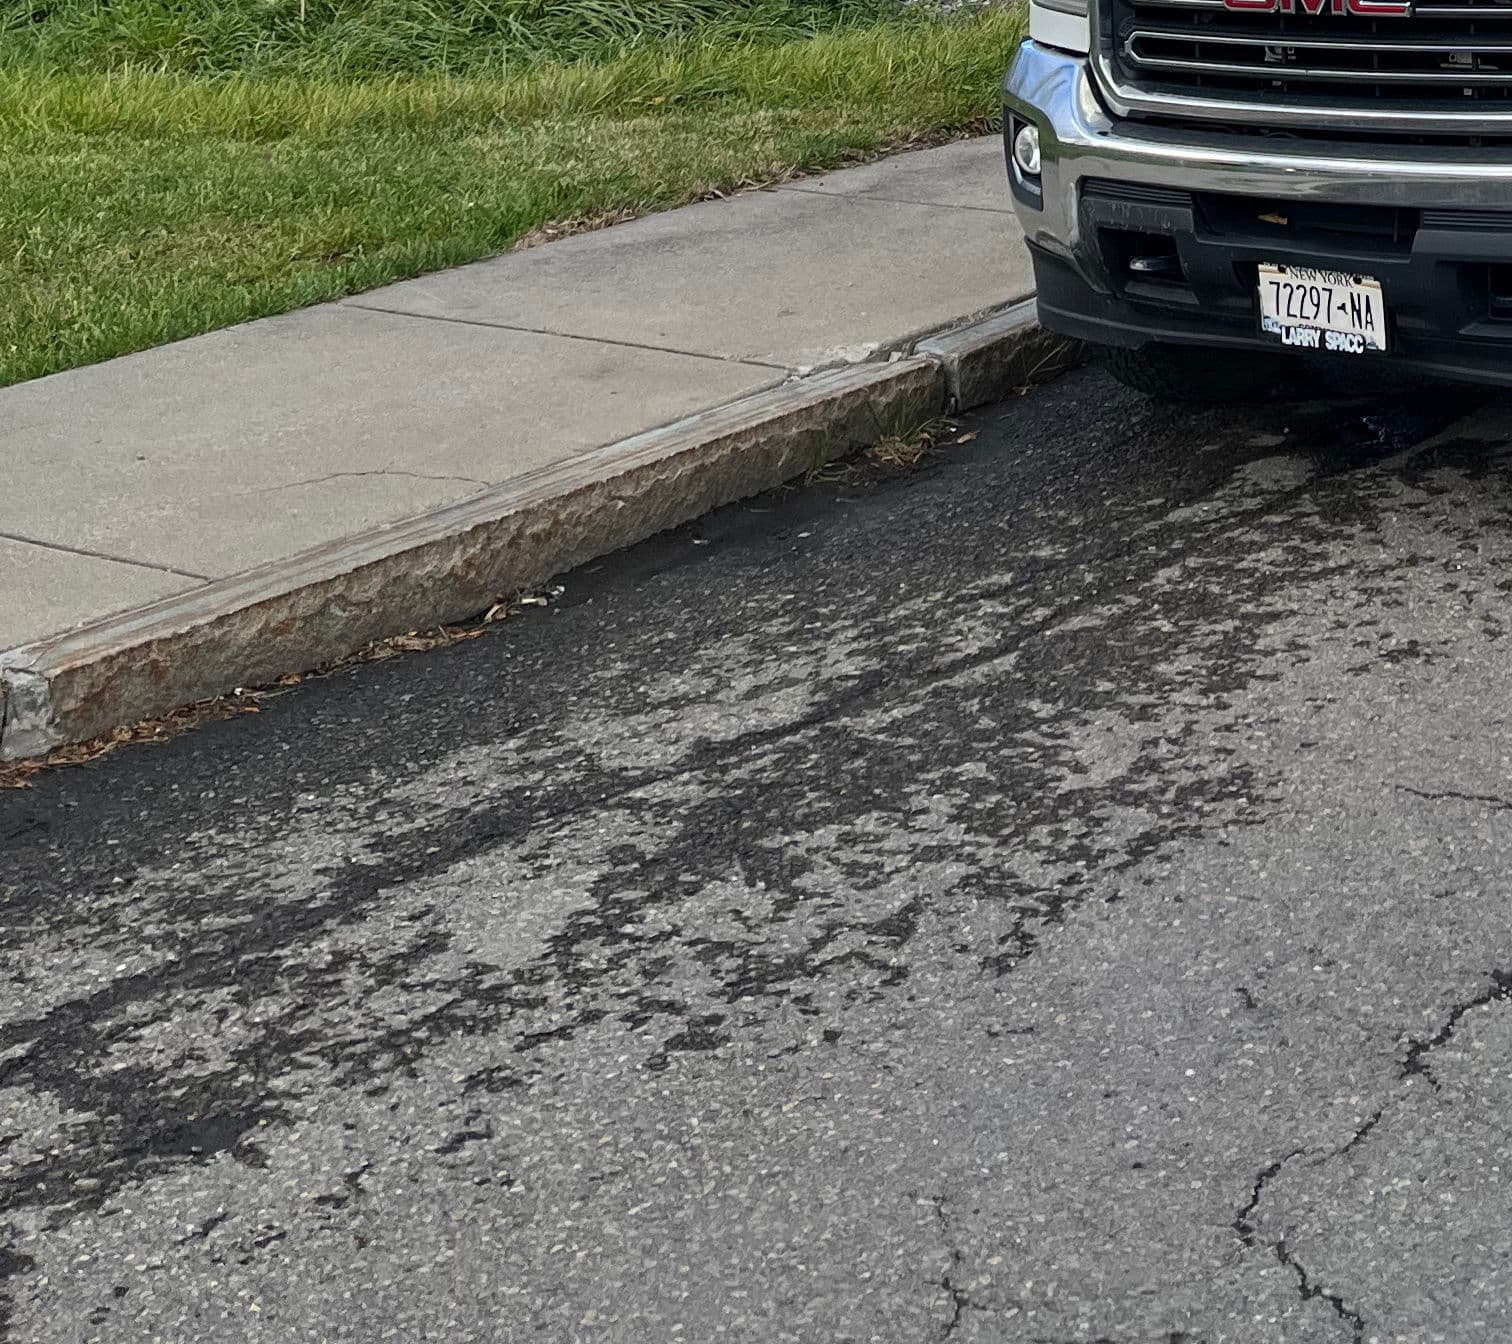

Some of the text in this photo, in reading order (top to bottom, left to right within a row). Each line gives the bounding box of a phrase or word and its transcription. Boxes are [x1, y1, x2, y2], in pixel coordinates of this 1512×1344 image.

[1287, 265, 1318, 282] NEW
[1317, 268, 1354, 289] YORK
[1281, 326, 1321, 349] LARRY
